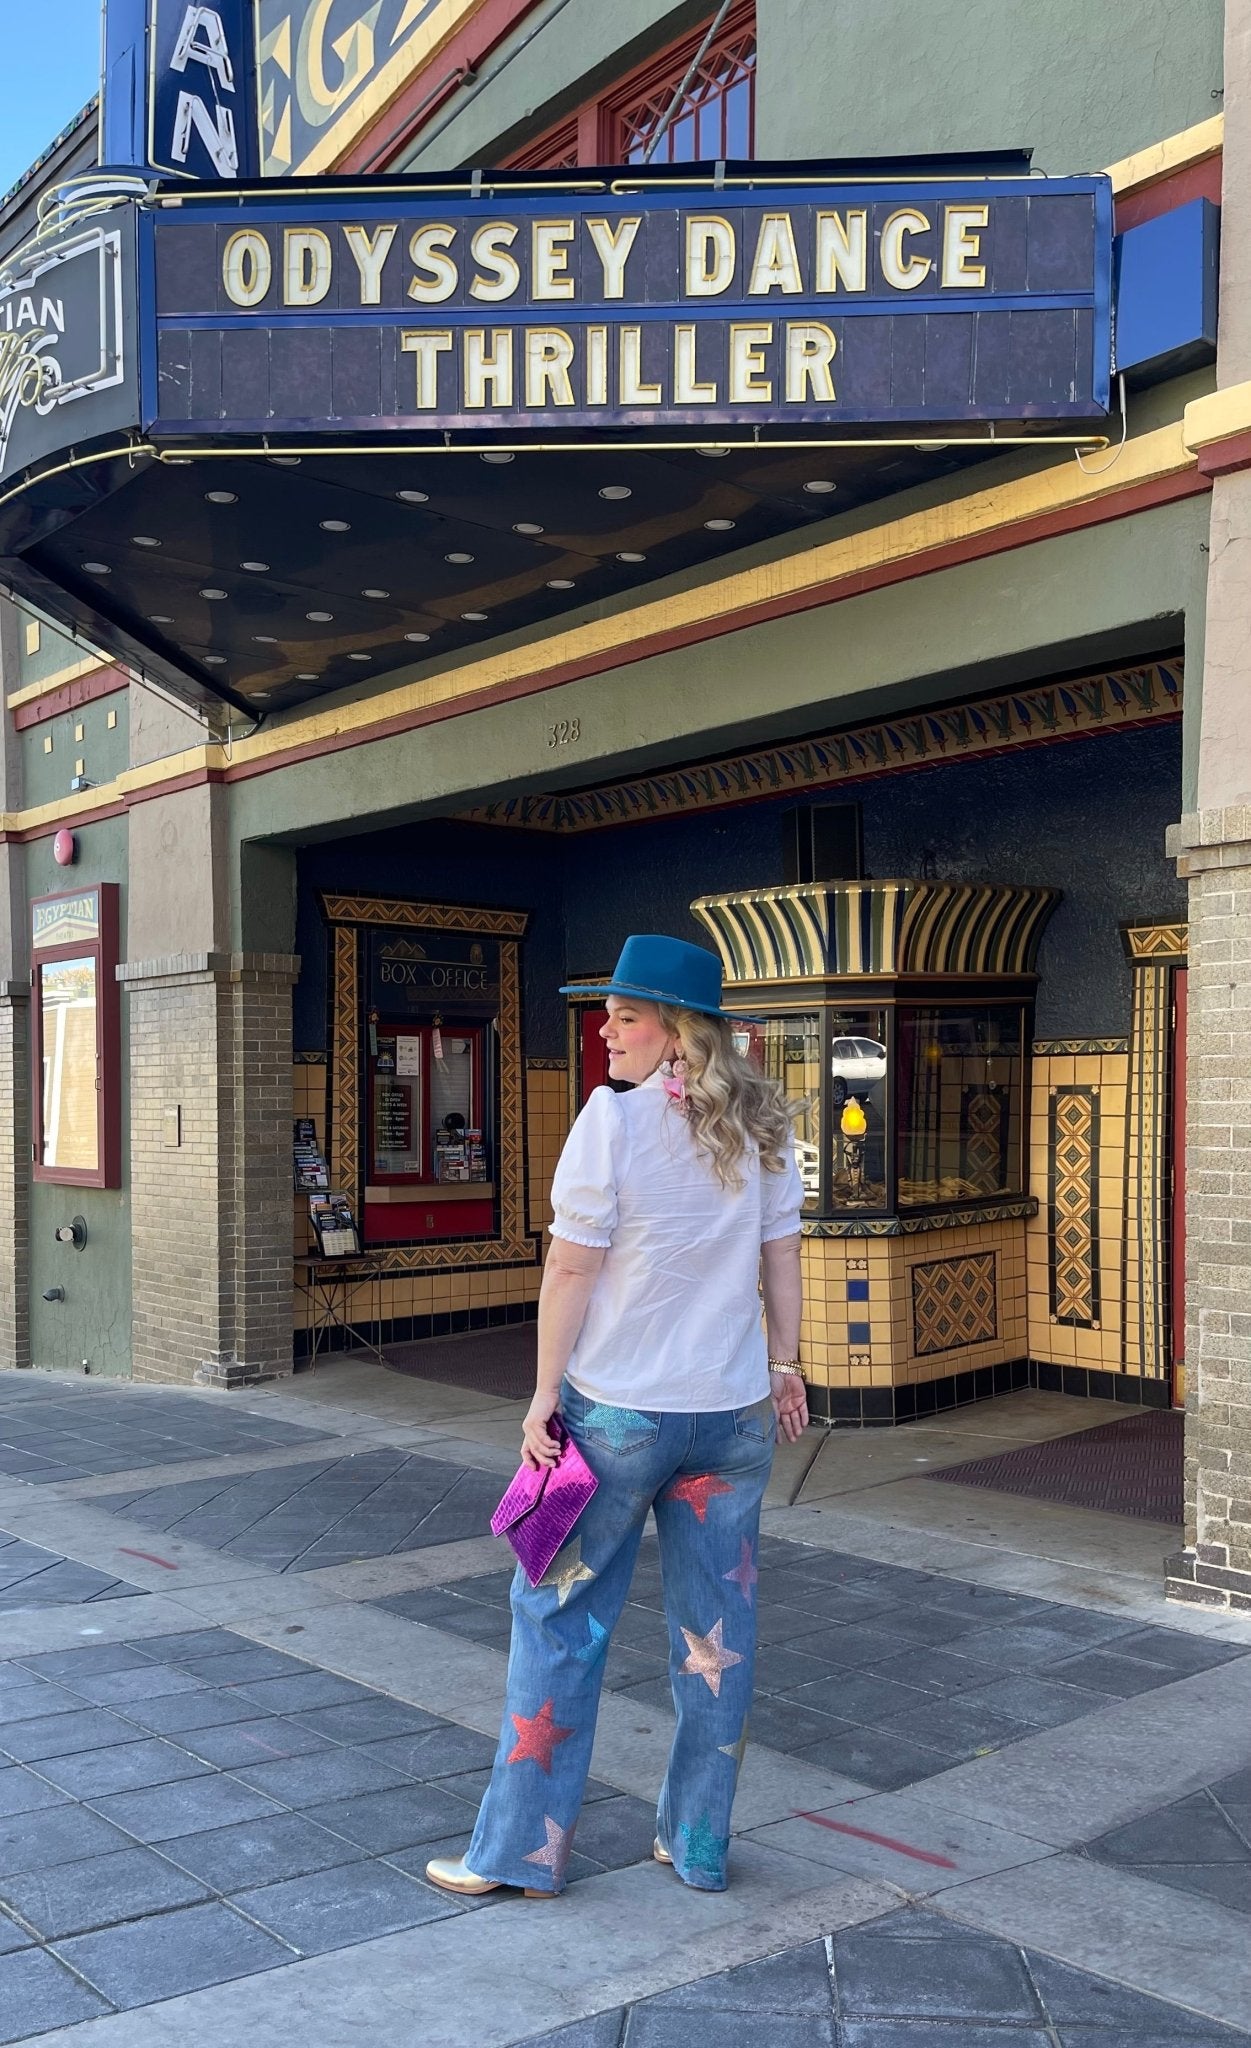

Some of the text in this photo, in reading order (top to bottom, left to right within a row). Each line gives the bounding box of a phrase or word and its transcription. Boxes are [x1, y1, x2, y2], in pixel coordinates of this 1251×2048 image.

[222, 204, 990, 308] ODYSSEY DANCE
[0, 296, 65, 333] IAN
[401, 321, 837, 410] THRILLER
[547, 717, 581, 748] 328
[36, 897, 95, 931] EGYPTIAN
[380, 962, 488, 990] BOX OFFICE
